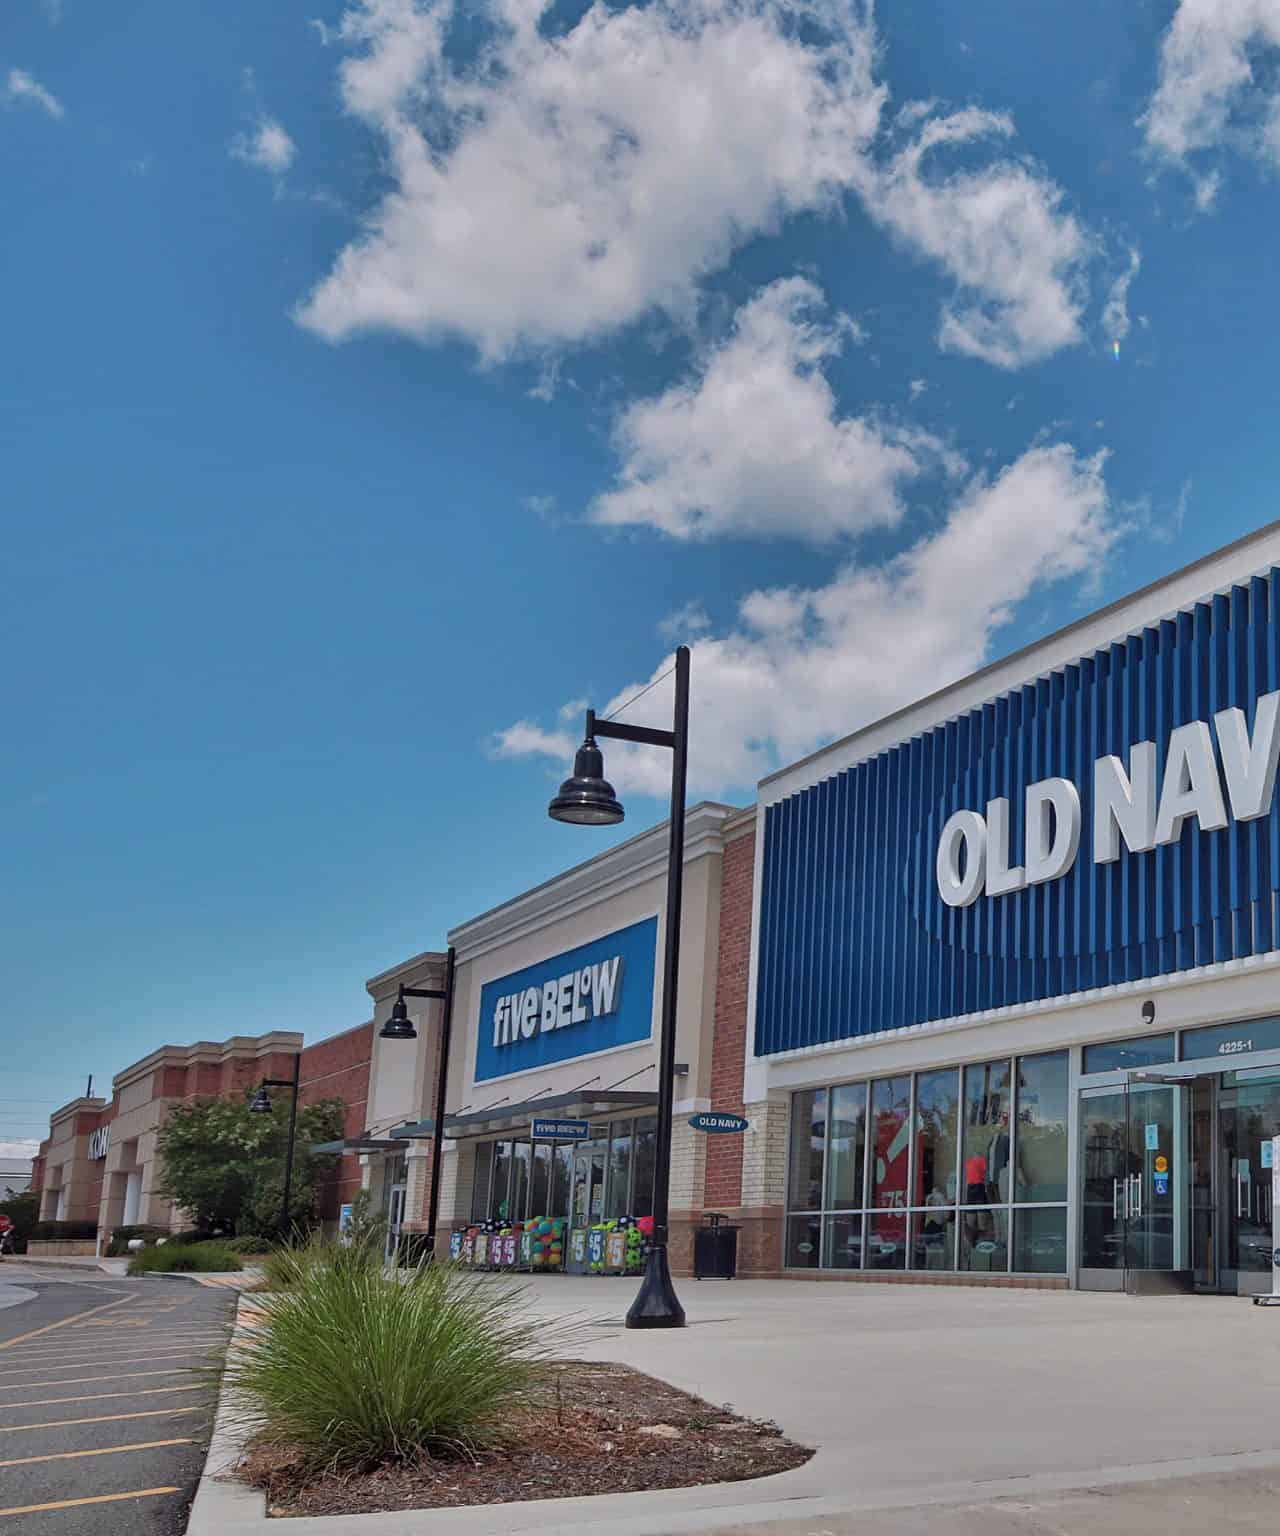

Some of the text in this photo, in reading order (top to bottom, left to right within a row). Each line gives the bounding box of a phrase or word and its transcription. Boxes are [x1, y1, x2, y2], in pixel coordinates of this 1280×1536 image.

[937, 776, 1081, 908] OLD
[1218, 1039, 1253, 1054] 4225-1
[699, 1116, 742, 1129] OLD NAVY
